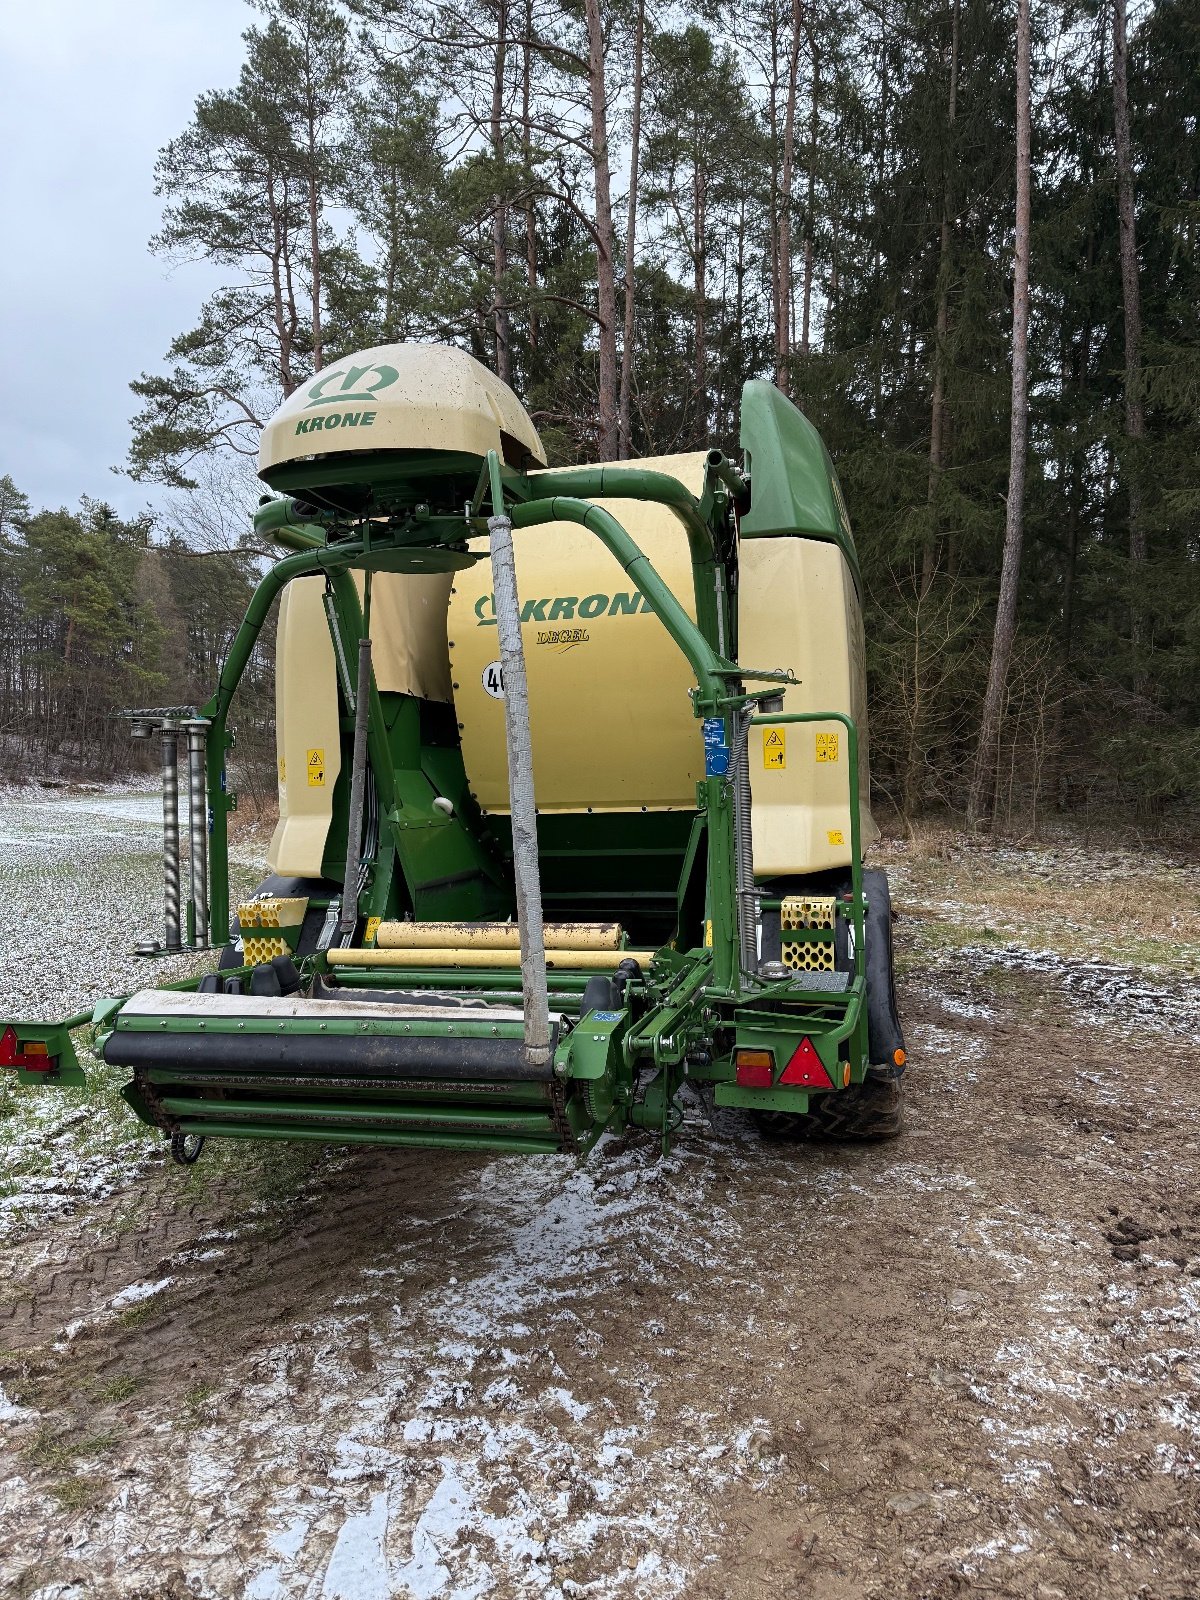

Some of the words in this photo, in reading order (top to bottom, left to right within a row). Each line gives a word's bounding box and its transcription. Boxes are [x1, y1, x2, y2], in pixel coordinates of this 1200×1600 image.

[294, 411, 378, 436] KRONE
[519, 591, 657, 623] KRON
[536, 628, 590, 645] DEGEL
